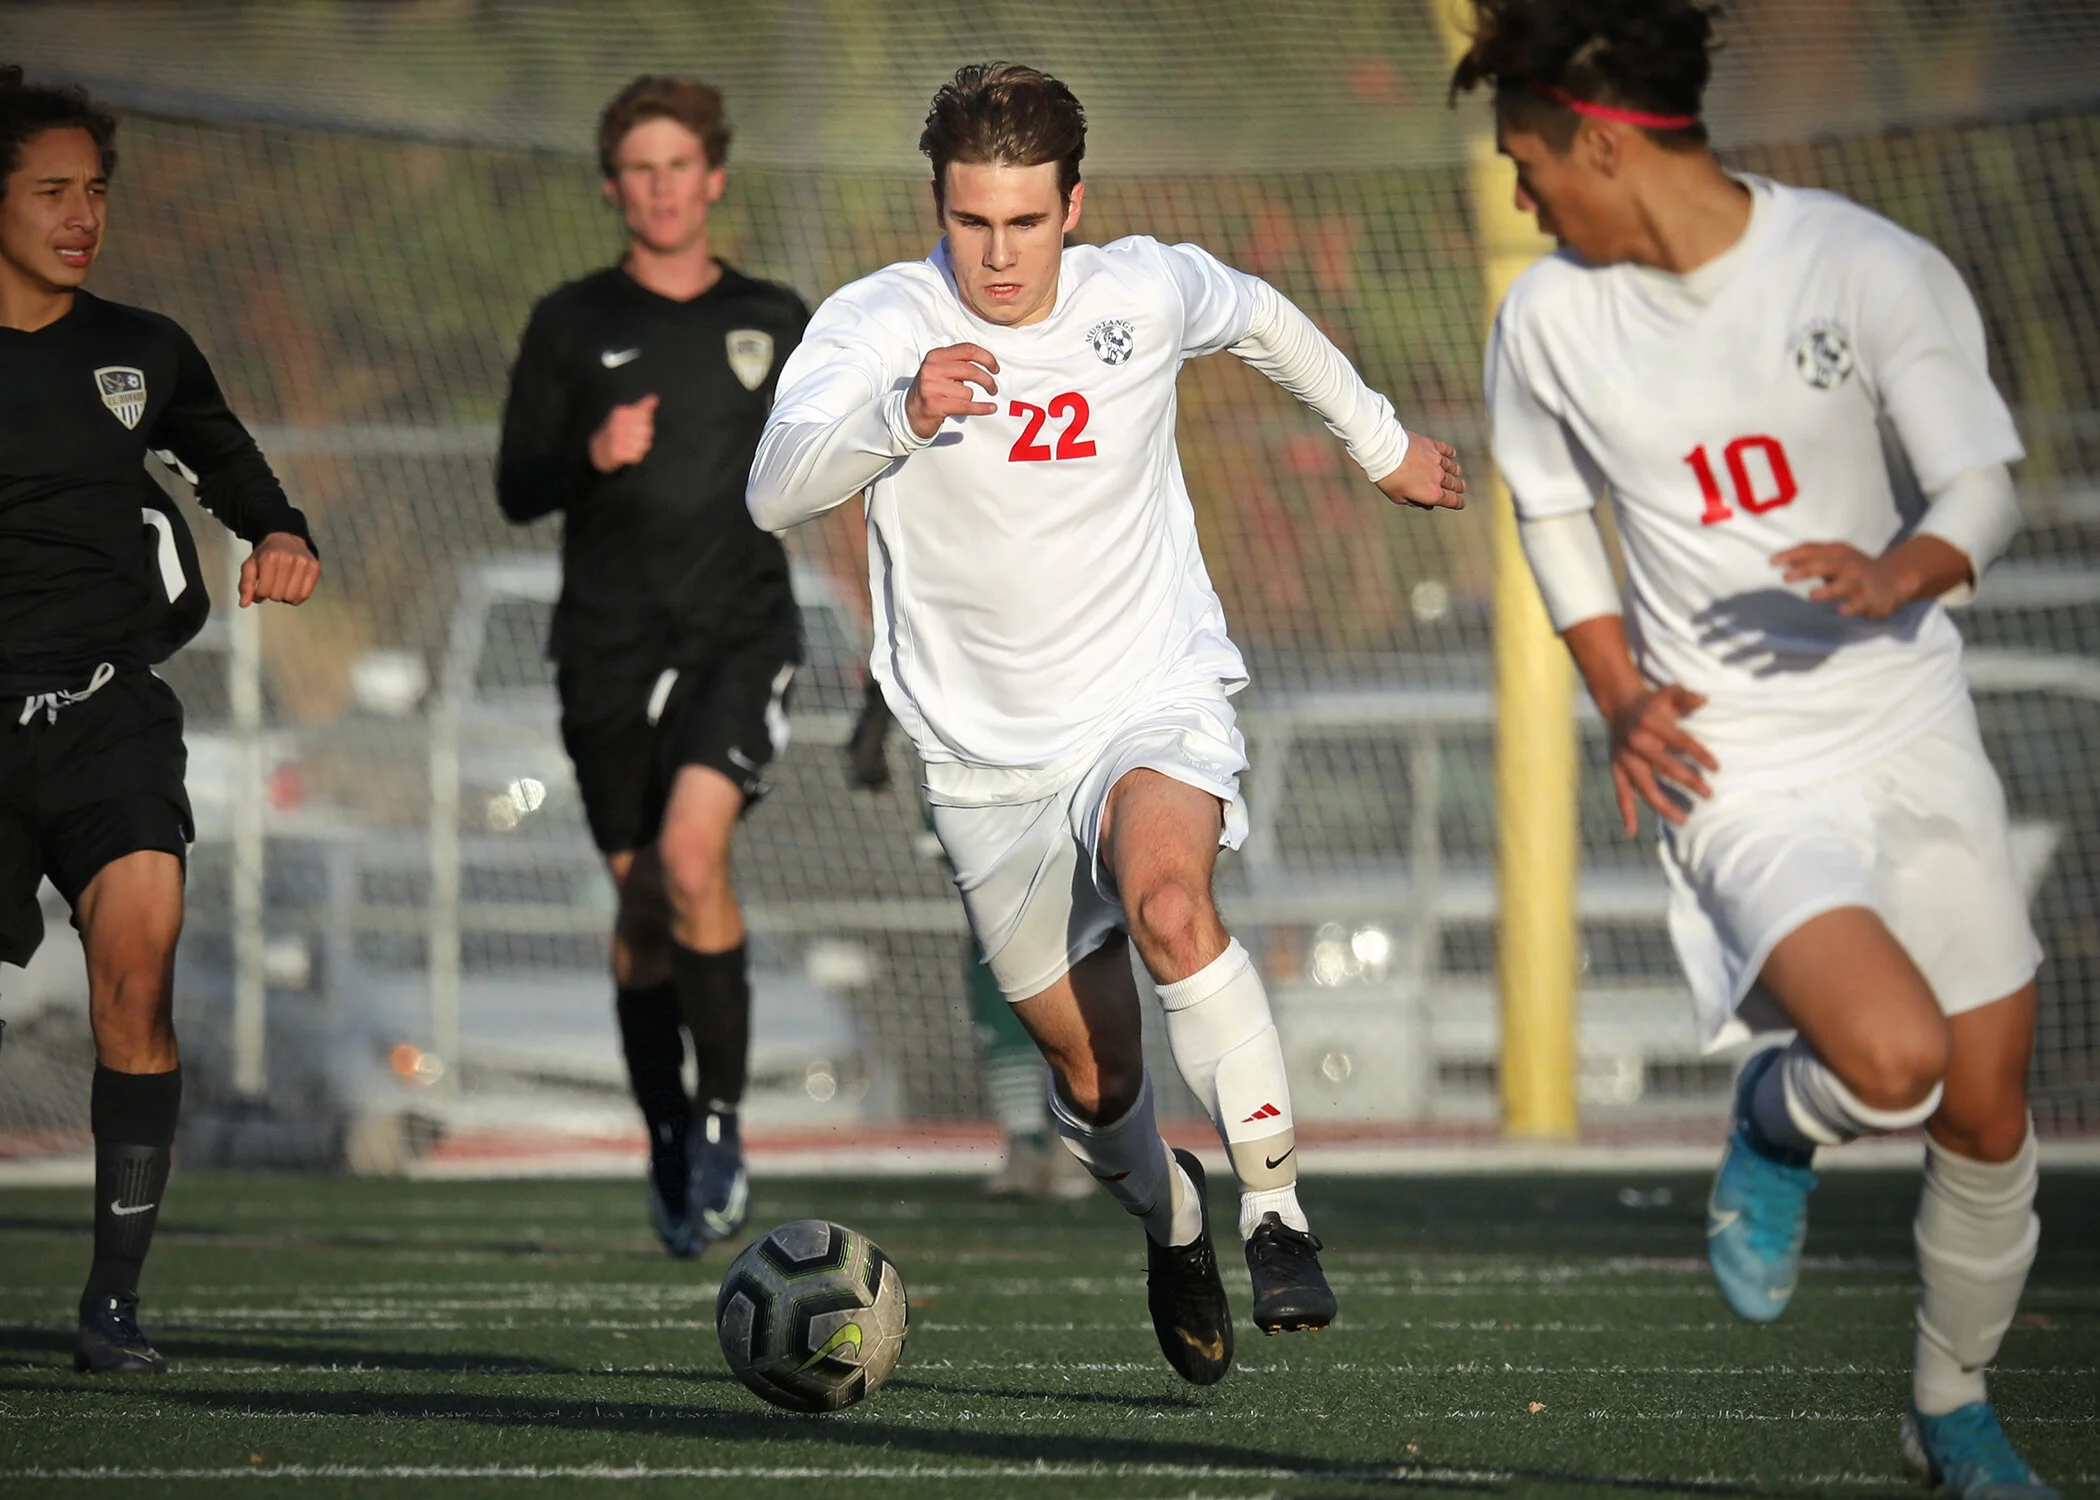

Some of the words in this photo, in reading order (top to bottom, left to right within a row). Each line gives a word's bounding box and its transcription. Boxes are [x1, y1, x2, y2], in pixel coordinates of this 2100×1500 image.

[1085, 319, 1136, 343] MUSTANGS
[1008, 391, 1097, 462] 22
[1682, 434, 1798, 526] 10
